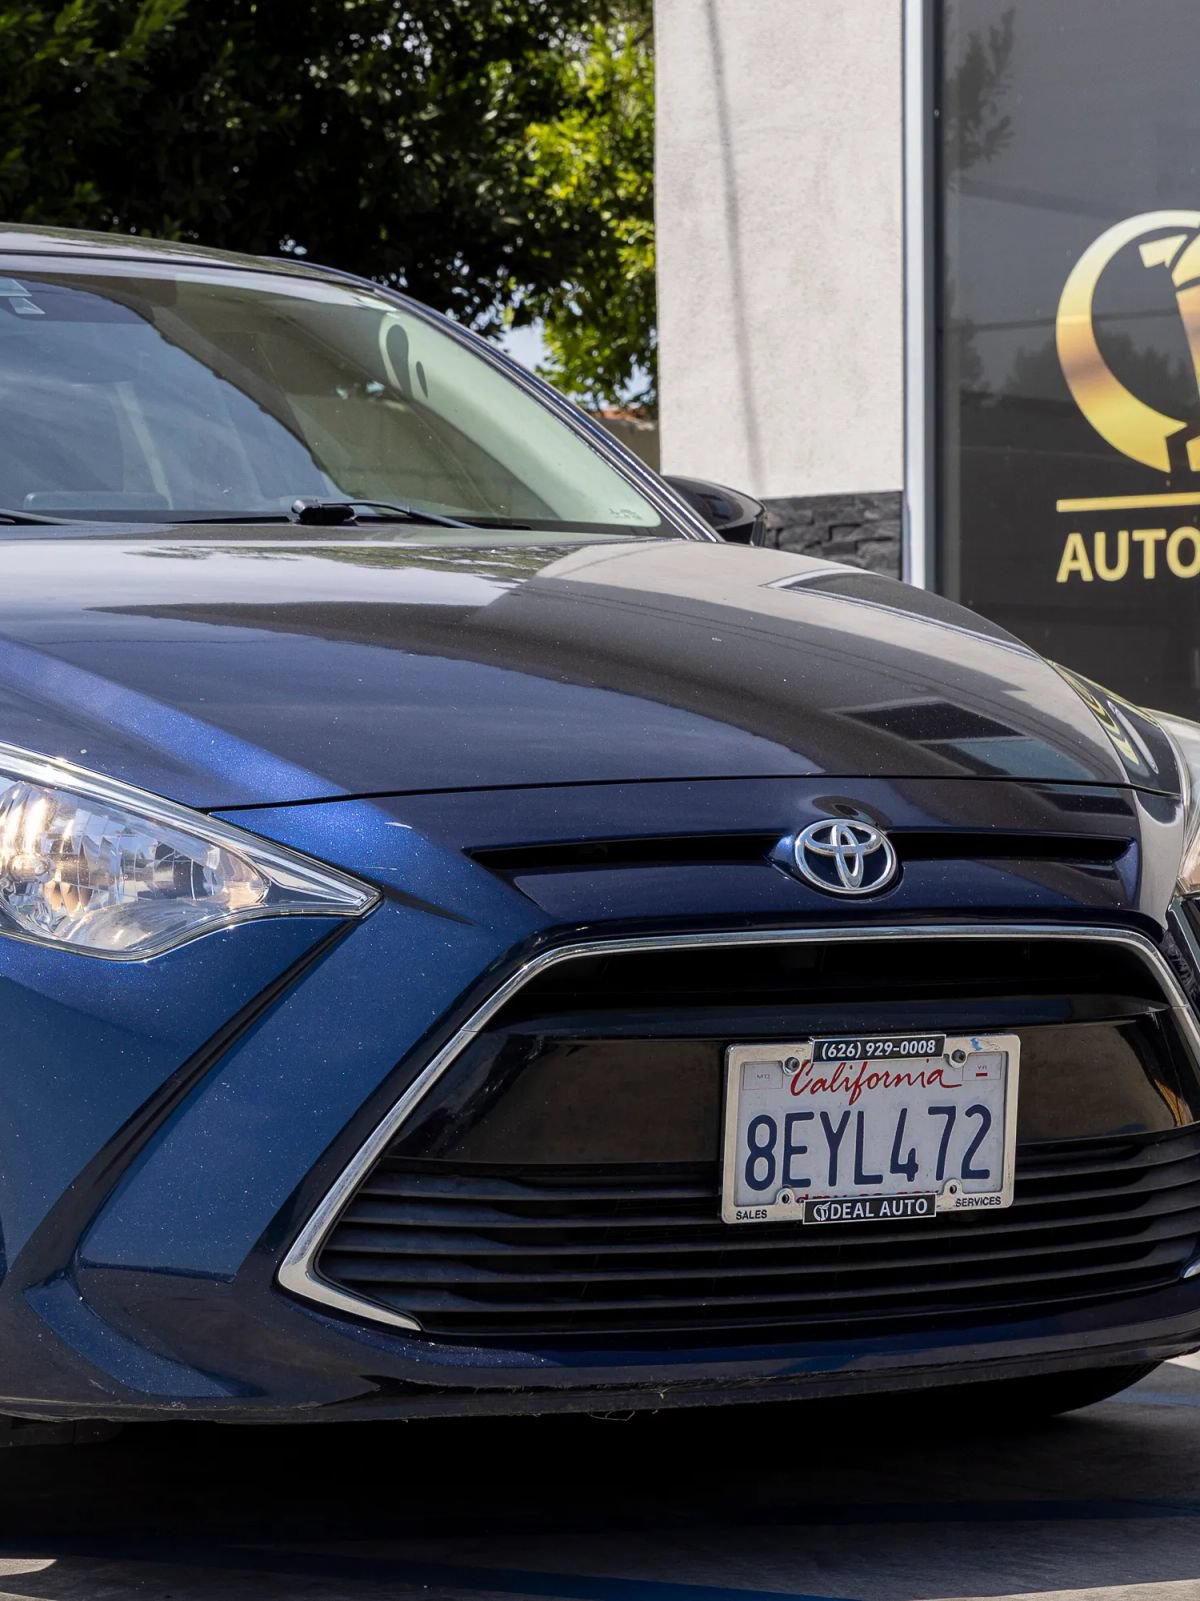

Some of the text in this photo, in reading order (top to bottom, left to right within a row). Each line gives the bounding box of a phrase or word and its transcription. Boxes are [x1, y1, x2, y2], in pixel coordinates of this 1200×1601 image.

[1056, 526, 1200, 582] AUTO
[820, 1039, 936, 1059] (626) 929-0008
[790, 1058, 962, 1105] California
[744, 1104, 992, 1191] 8EYL472
[880, 1198, 928, 1217] AUTO
[954, 1196, 1002, 1208] SERVICES
[735, 1208, 768, 1221] SALES
